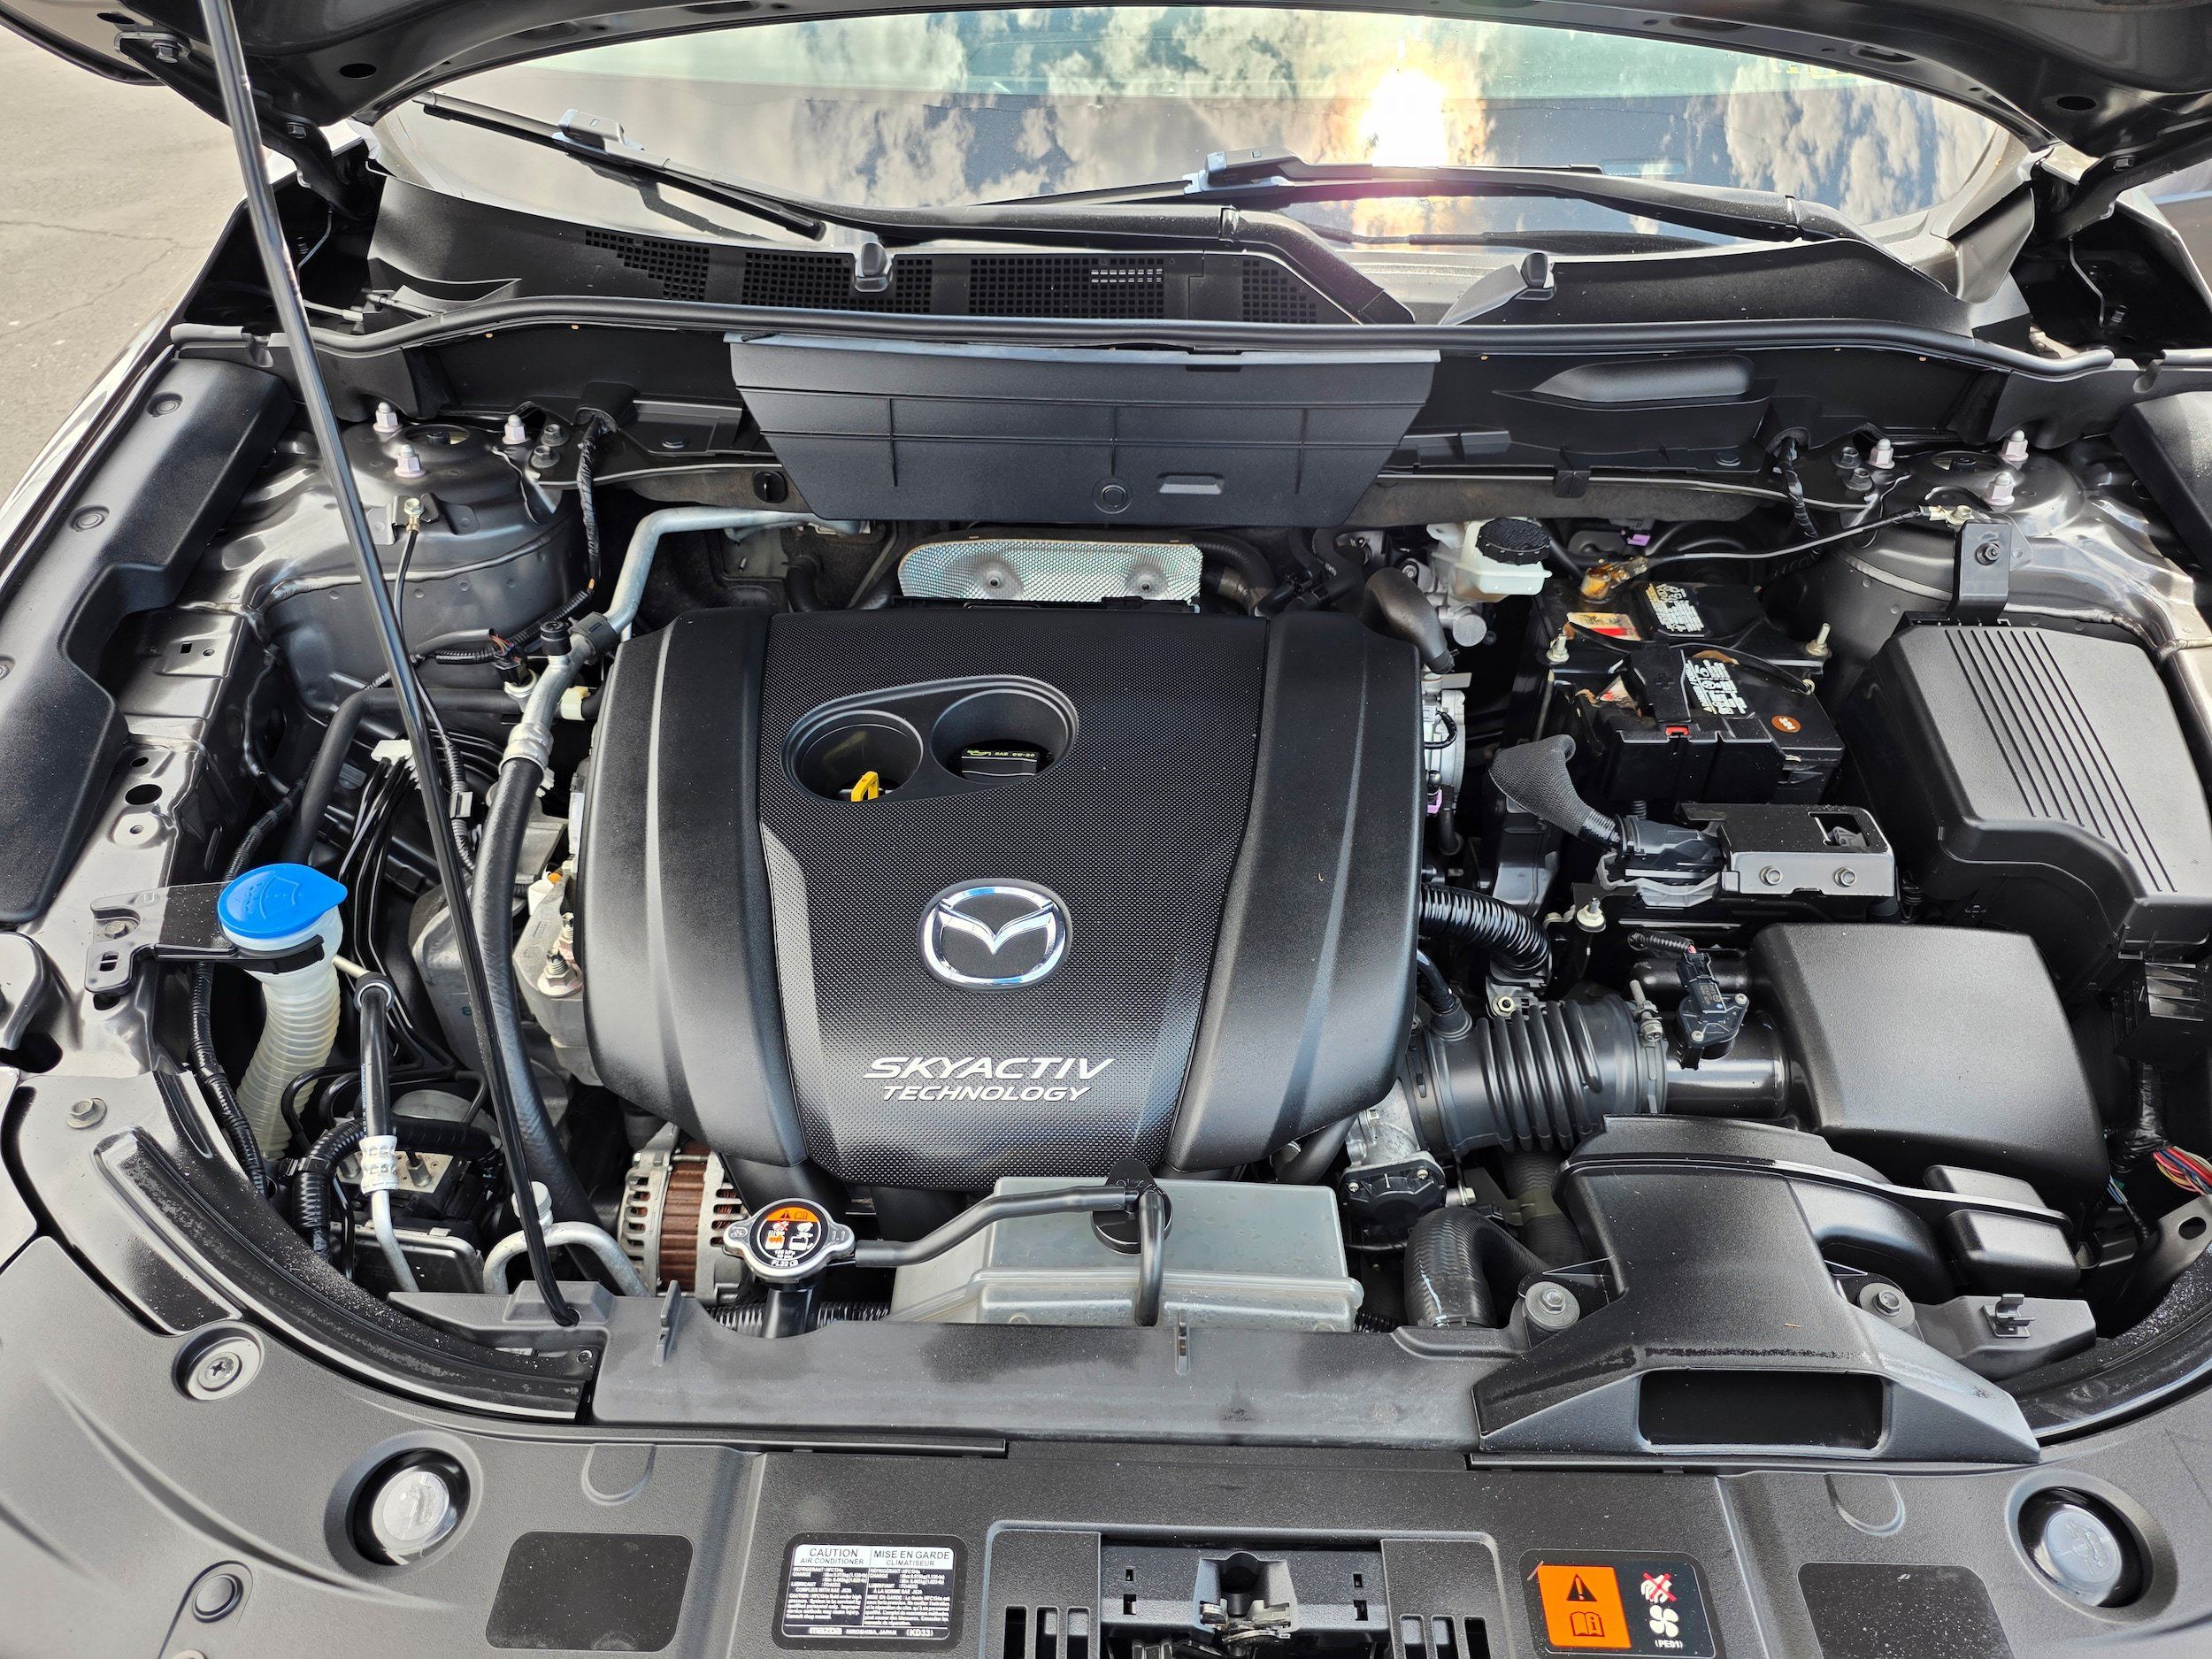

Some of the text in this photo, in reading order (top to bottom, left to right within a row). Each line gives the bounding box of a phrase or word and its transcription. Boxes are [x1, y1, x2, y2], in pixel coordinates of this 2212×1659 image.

[863, 1056, 1116, 1079] SKYACTIV
[883, 1085, 1092, 1102] TECHNOLOGY
[810, 1548, 858, 1557] CAUTION
[900, 1550, 913, 1559] EN
[1655, 1639, 1684, 1649] (PE01)
